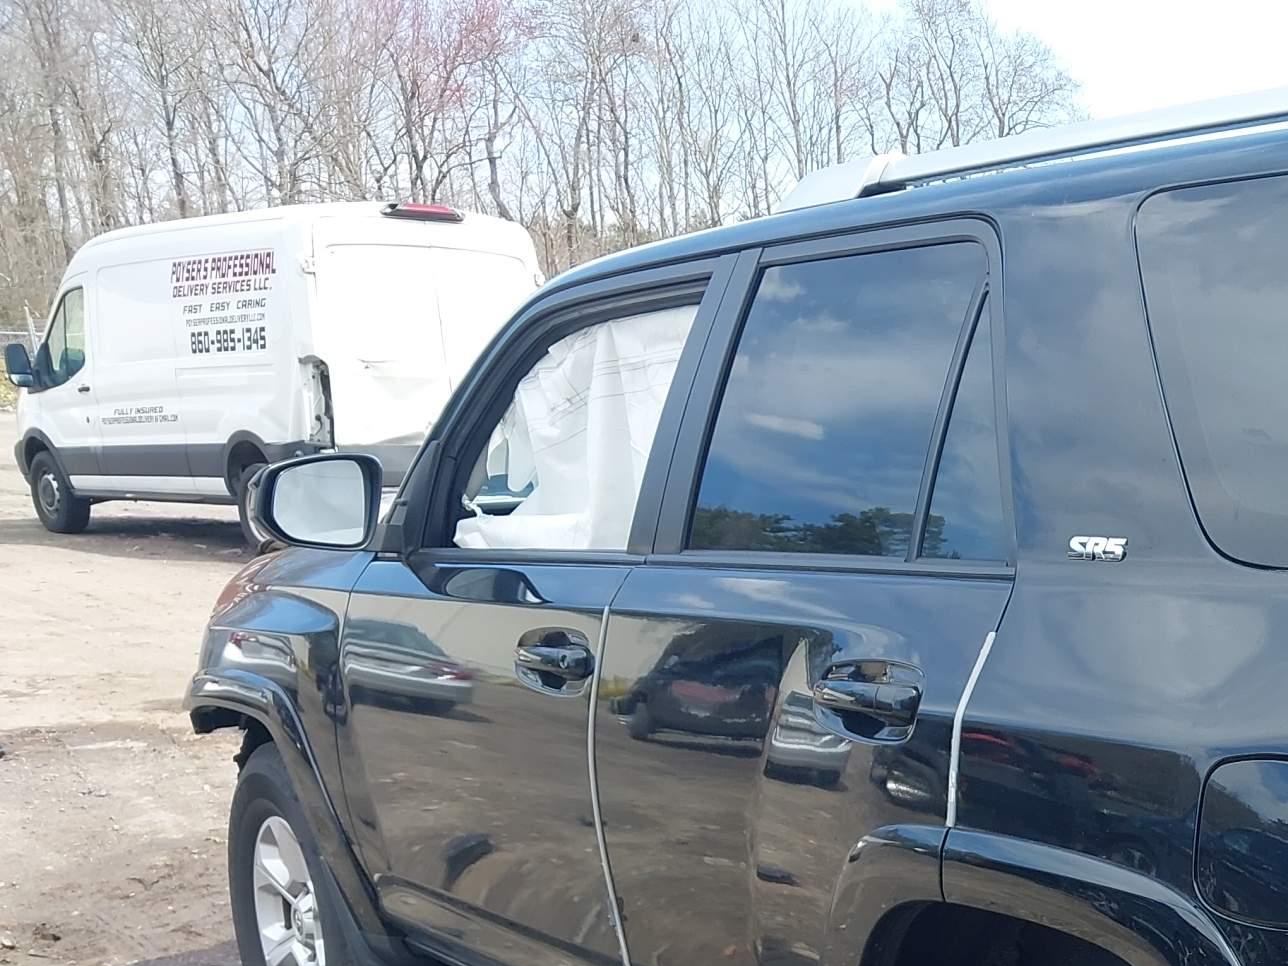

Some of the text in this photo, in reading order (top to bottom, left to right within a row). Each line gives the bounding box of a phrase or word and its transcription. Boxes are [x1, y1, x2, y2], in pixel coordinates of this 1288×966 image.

[210, 251, 277, 279] PROFESSIONAL
[172, 282, 209, 298] DELIVERY
[211, 279, 252, 295] SERVICES
[182, 298, 266, 315] FAST EASY CARING
[190, 326, 267, 353] 860-985-1345
[134, 405, 164, 414] INSURED
[1067, 535, 1128, 562] SR5
